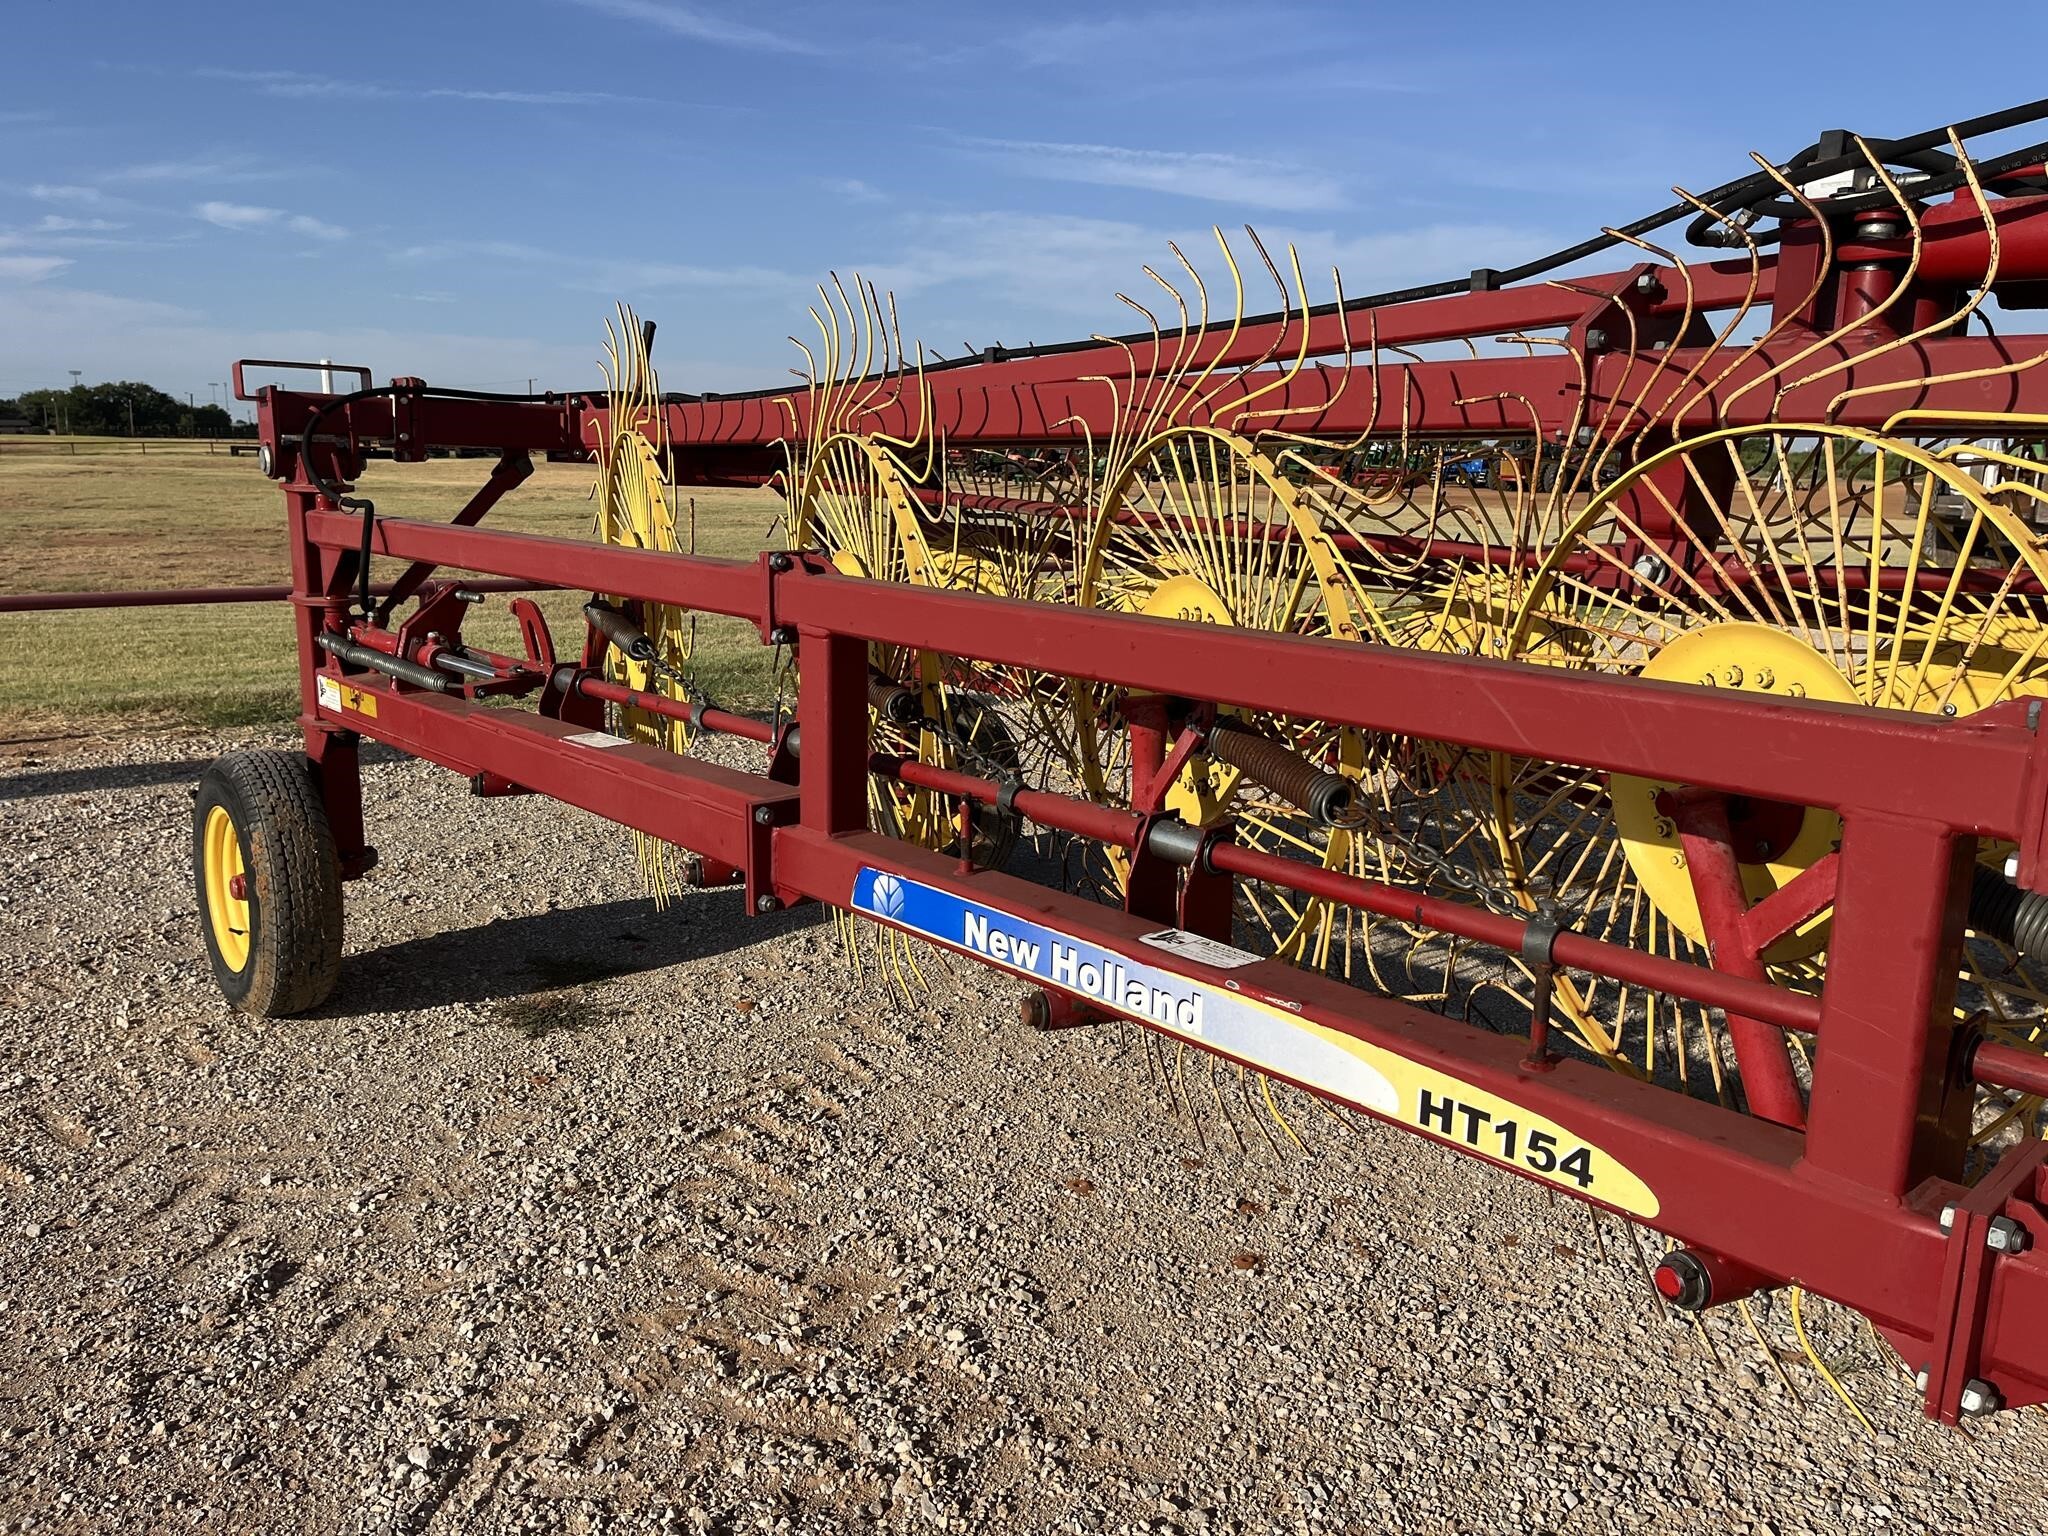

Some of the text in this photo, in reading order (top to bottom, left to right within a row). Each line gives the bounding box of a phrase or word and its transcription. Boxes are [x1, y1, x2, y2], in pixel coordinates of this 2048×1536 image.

[964, 910, 1203, 1037] New Holland
[1419, 1088, 1594, 1189] HT154
